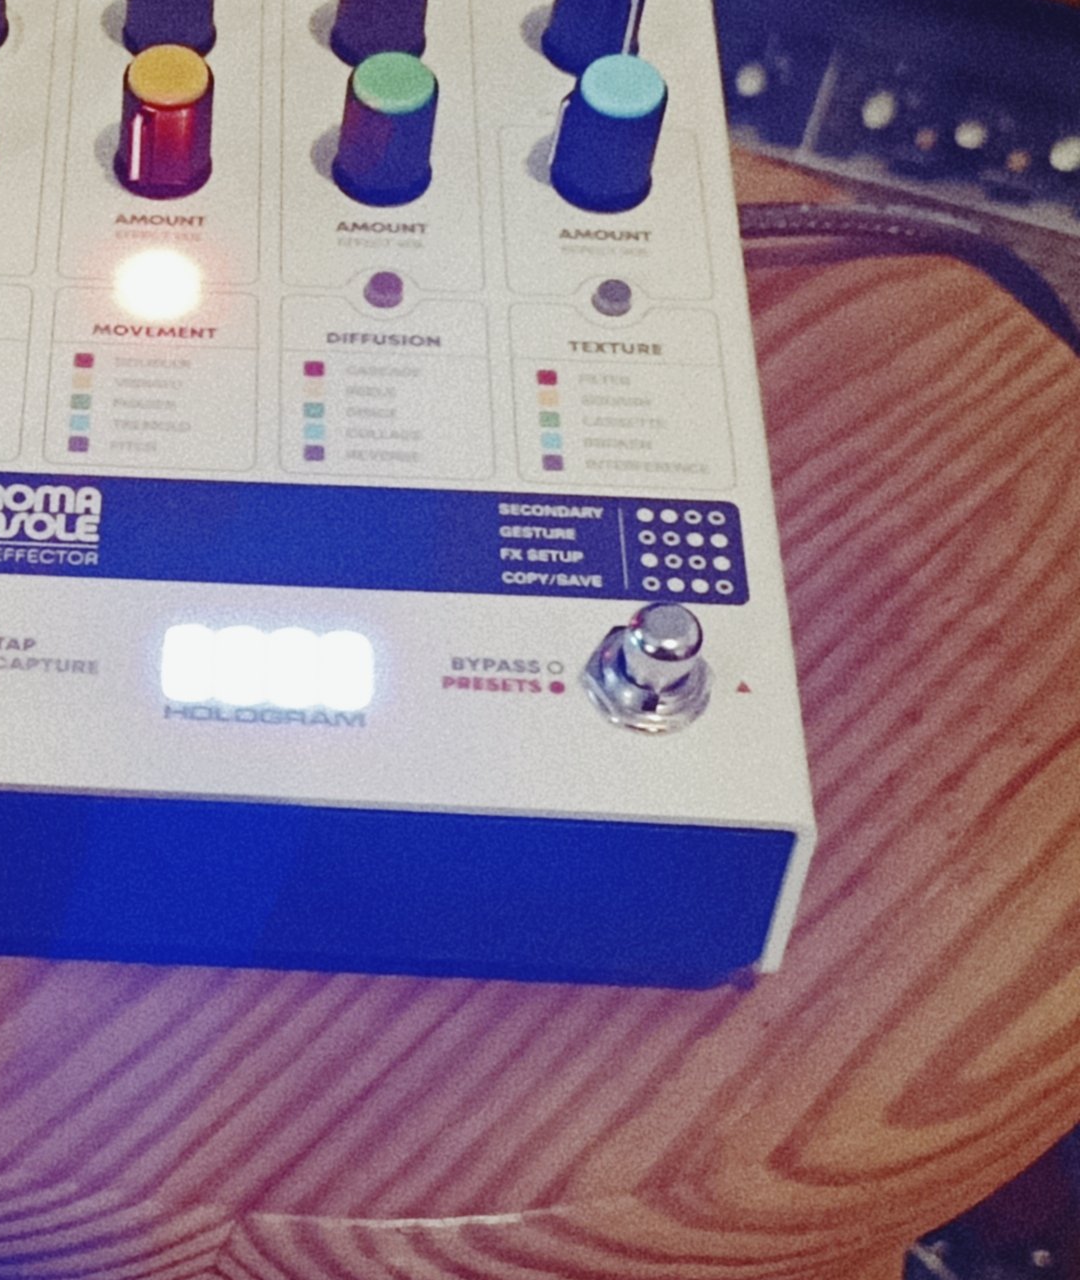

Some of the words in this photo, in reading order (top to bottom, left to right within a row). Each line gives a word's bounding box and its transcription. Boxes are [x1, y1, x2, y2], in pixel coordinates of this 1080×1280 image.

[115, 213, 205, 227] AMOUNT
[336, 220, 428, 234] AMOUNT
[559, 228, 652, 241] AMOUNT
[92, 323, 218, 339] MOVEMENT
[326, 332, 442, 348] DIFFUSION
[569, 339, 663, 356] TEXTURE
[498, 502, 604, 521] SECONDARY
[499, 524, 577, 541] GESTURE
[499, 547, 522, 562] FX
[526, 548, 584, 564] SETUP
[501, 570, 603, 588] COPY/SAVE
[451, 656, 541, 675] BYPASS
[442, 675, 543, 695] PRESETS
[163, 705, 367, 727] HOLOGRAM
